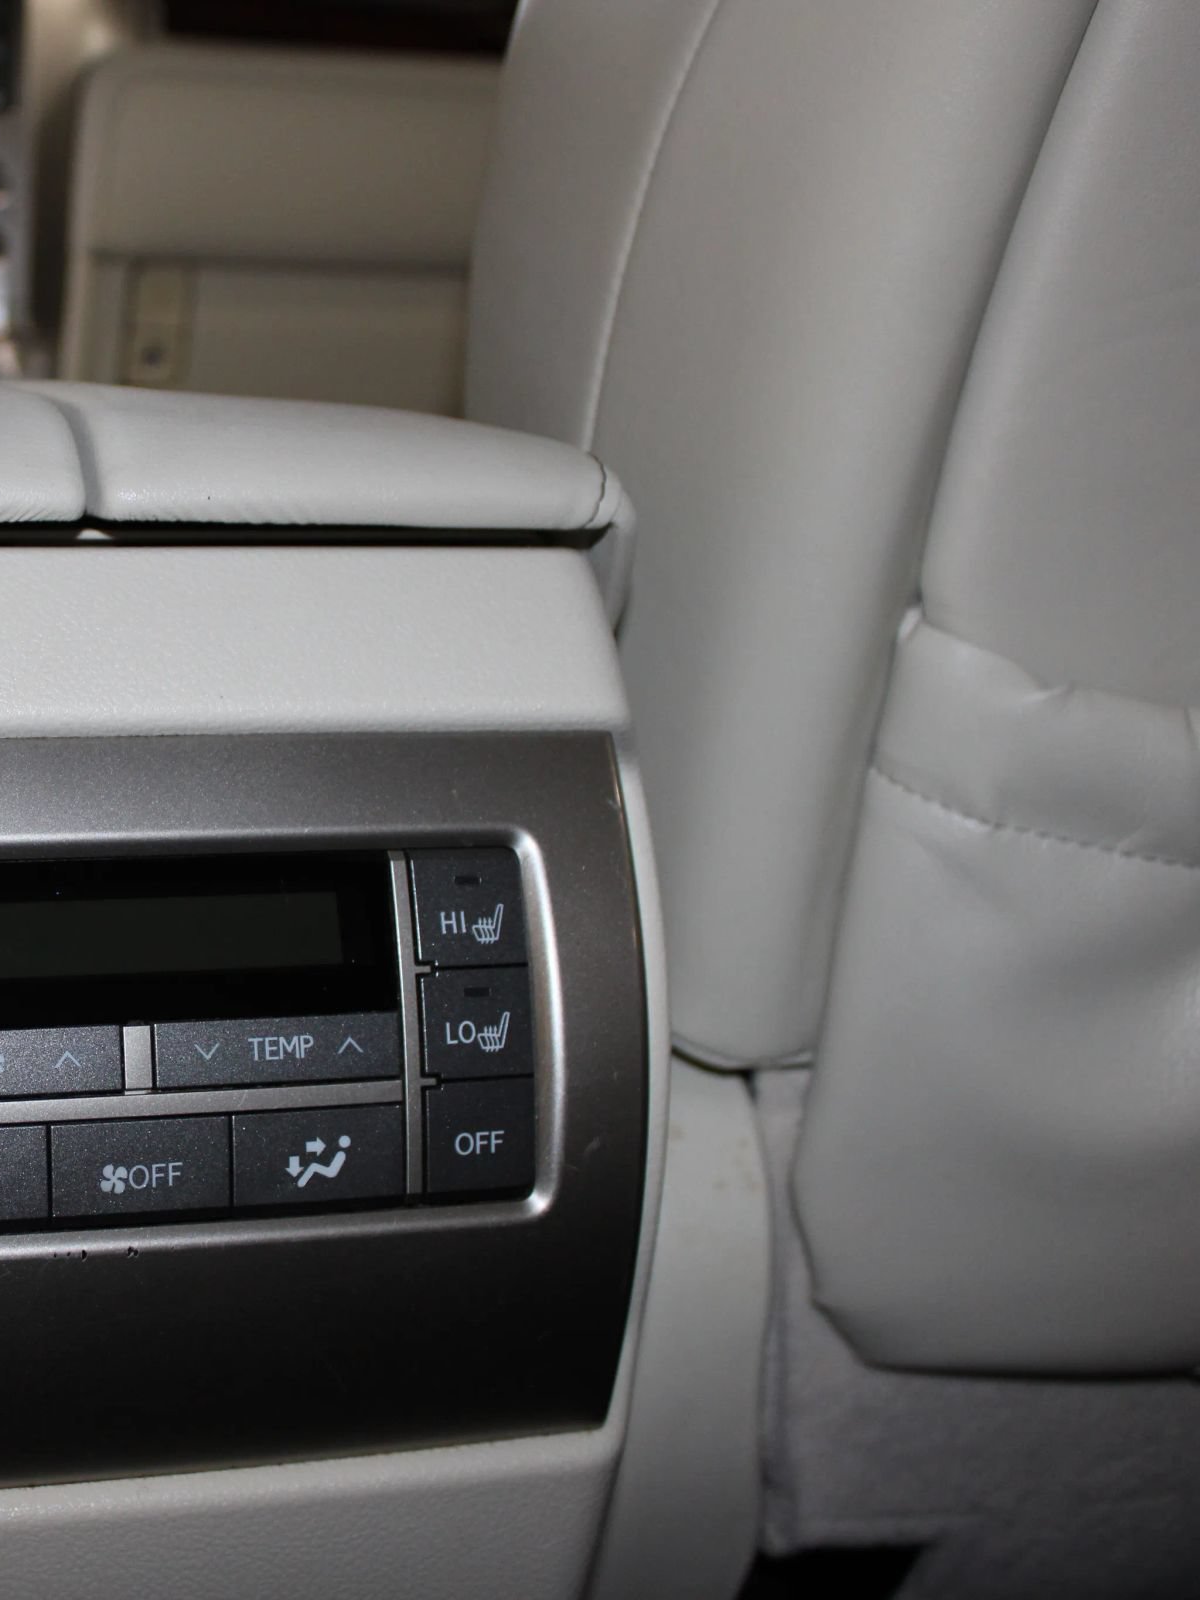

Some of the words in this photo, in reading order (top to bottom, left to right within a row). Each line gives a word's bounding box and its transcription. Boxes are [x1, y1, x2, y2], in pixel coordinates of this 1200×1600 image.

[440, 911, 467, 935] HI
[445, 1020, 476, 1046] LO
[248, 1035, 315, 1062] TEMP
[454, 1130, 505, 1156] OFF
[128, 1161, 184, 1189] OFF
